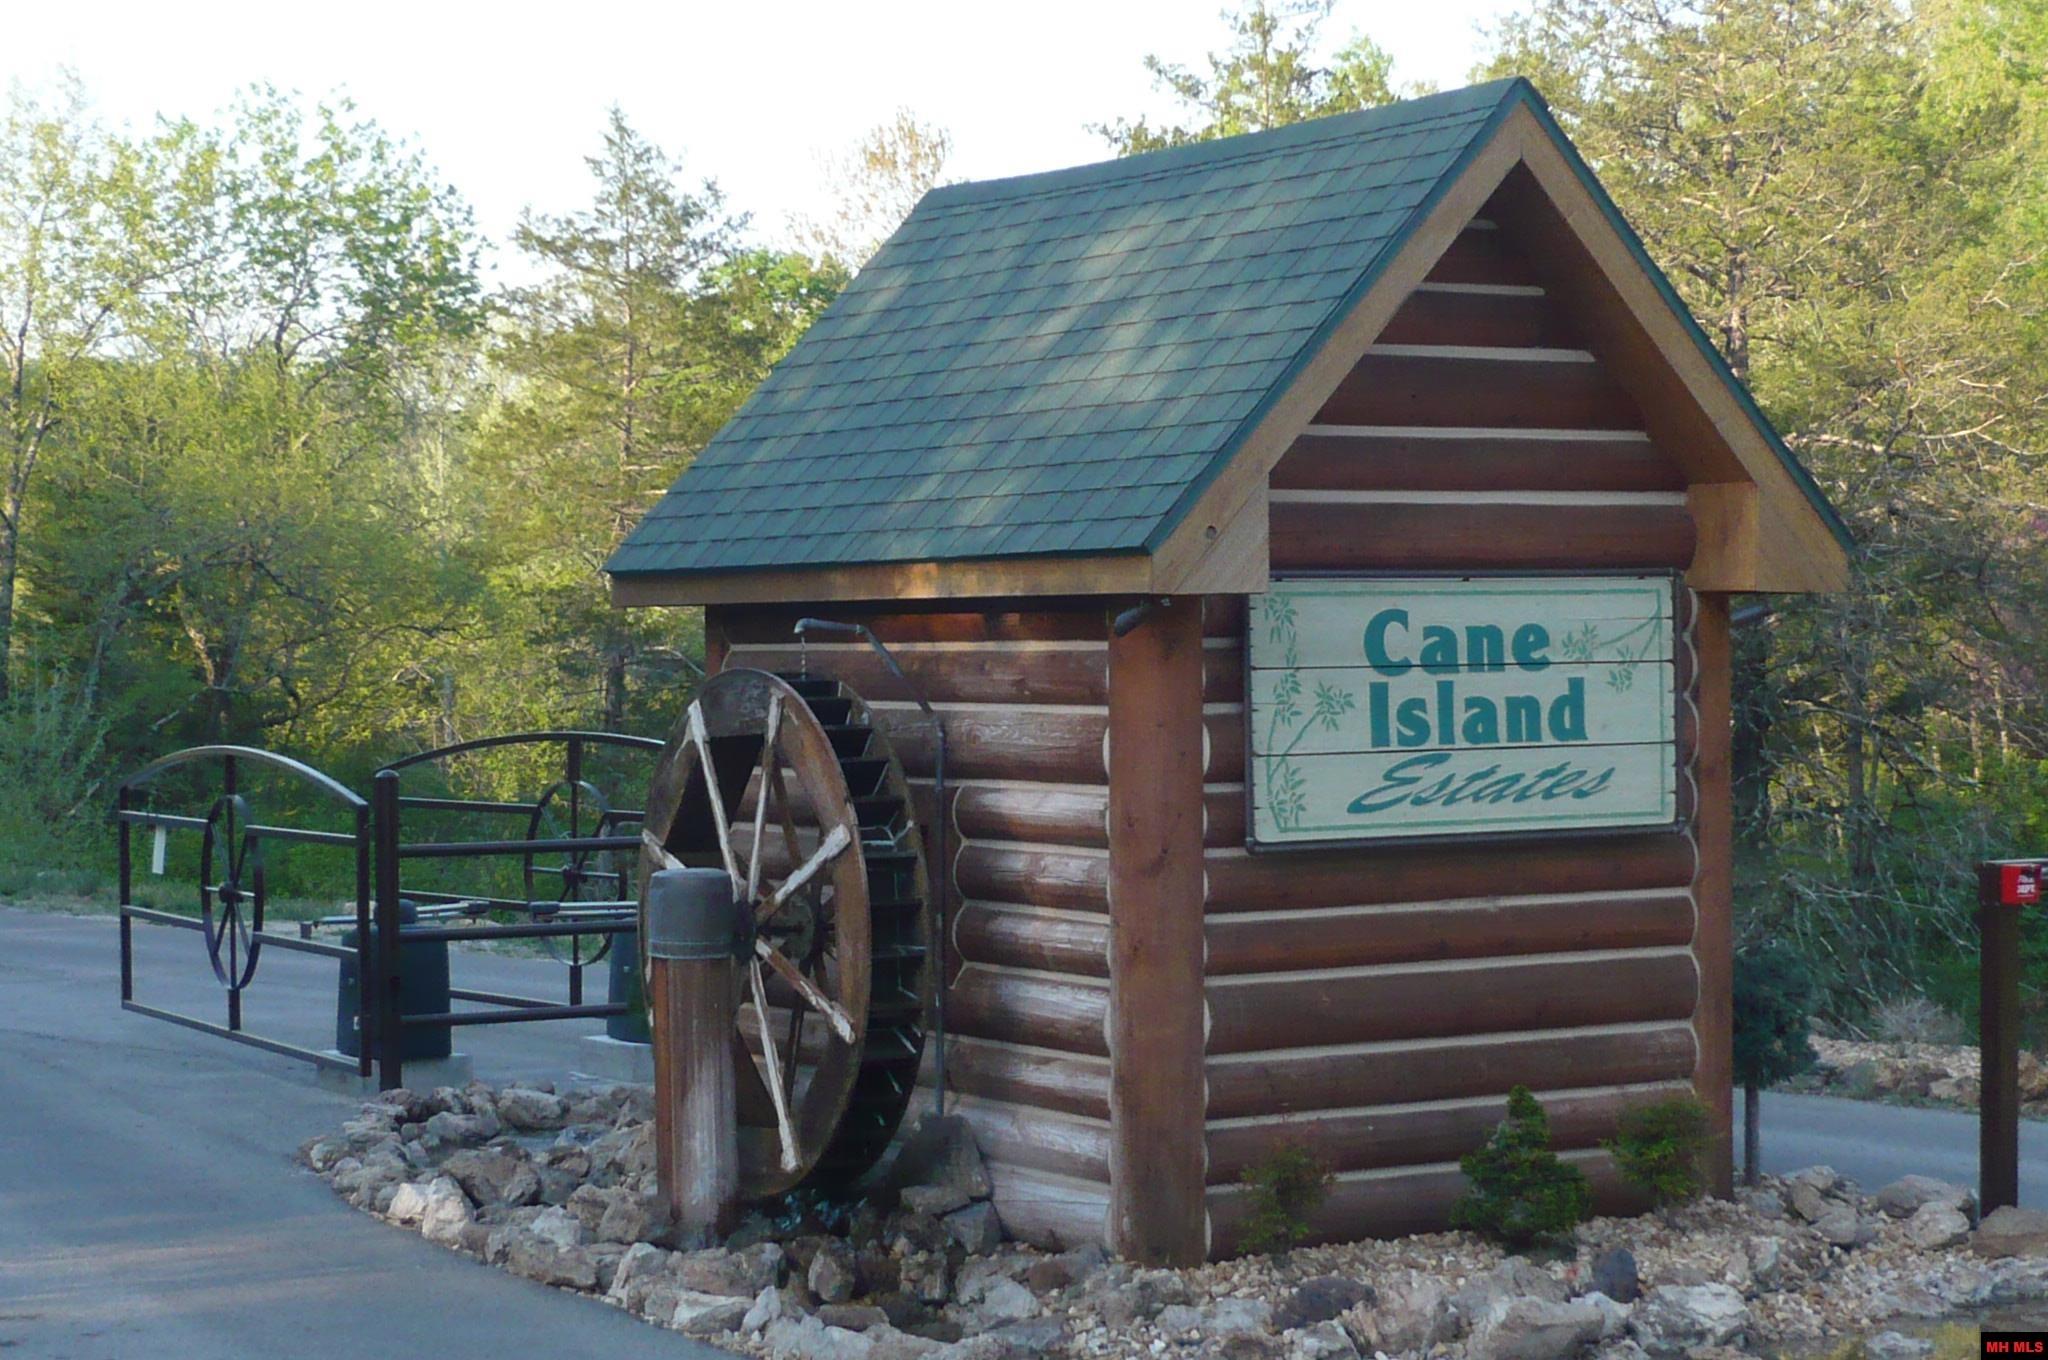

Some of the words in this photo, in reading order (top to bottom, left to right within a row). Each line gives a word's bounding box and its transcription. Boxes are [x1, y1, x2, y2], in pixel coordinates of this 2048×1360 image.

[1364, 608, 1551, 676] Cane
[1369, 677, 1588, 748] Island
[1346, 752, 1616, 814] Estates
